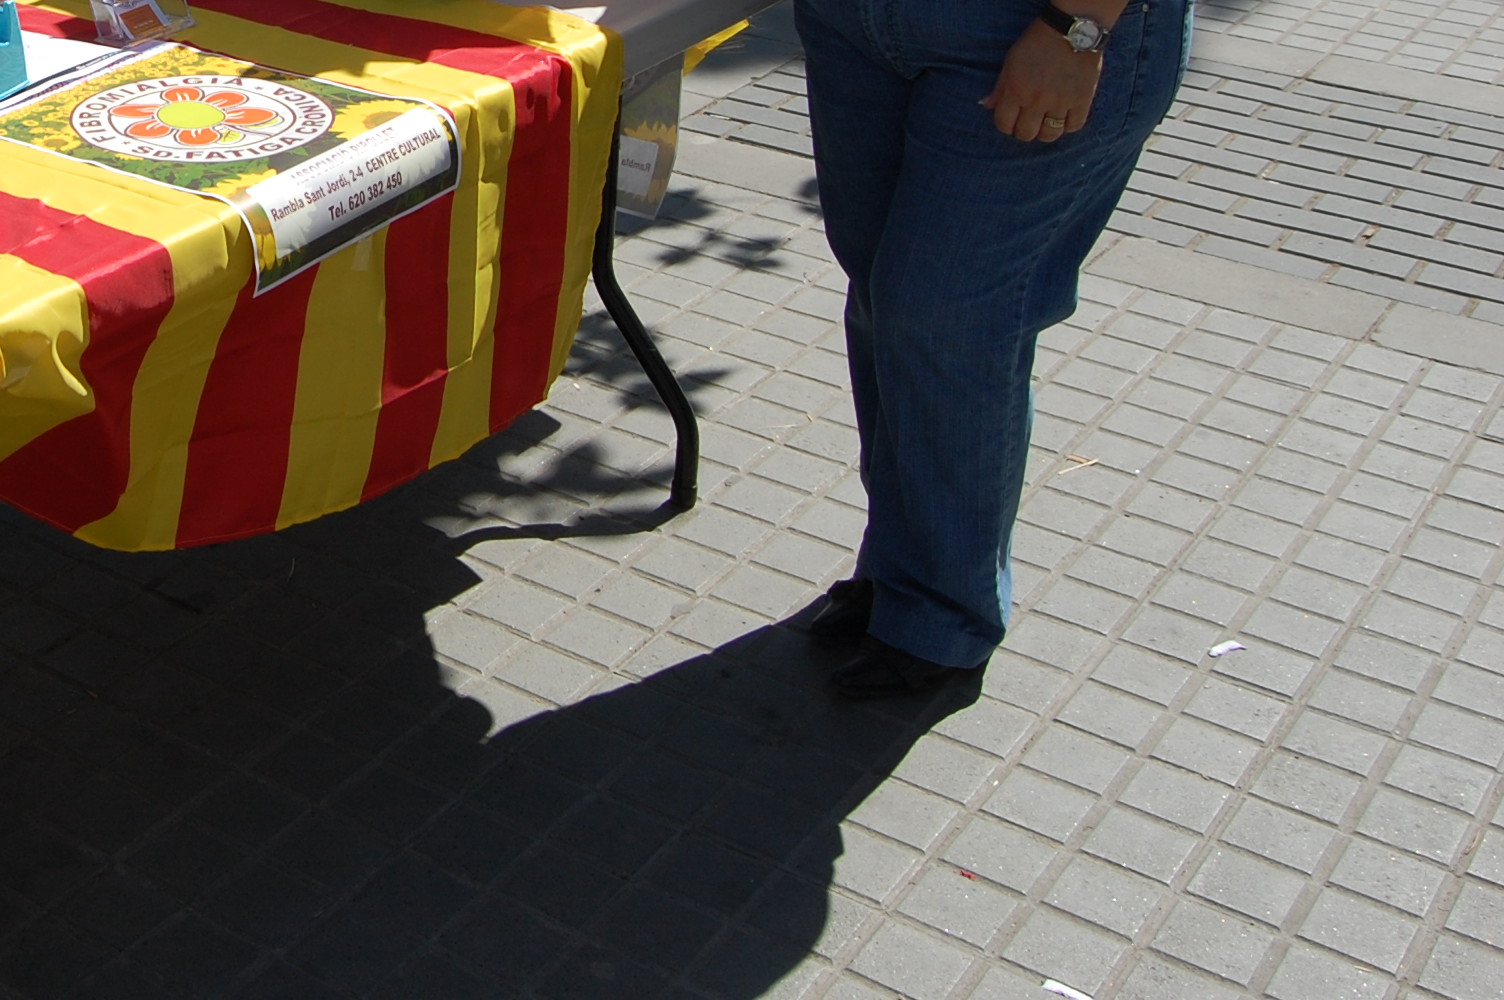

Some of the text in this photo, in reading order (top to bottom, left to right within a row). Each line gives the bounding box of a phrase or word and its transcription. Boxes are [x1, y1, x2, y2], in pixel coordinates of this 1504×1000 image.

[270, 198, 305, 223] Rambla
[306, 185, 326, 205] Sant
[326, 174, 351, 194] Jordi,
[366, 147, 399, 173] CENTRE
[398, 128, 441, 156] CULTURAL
[327, 171, 403, 222] Tel. 620 382 450
